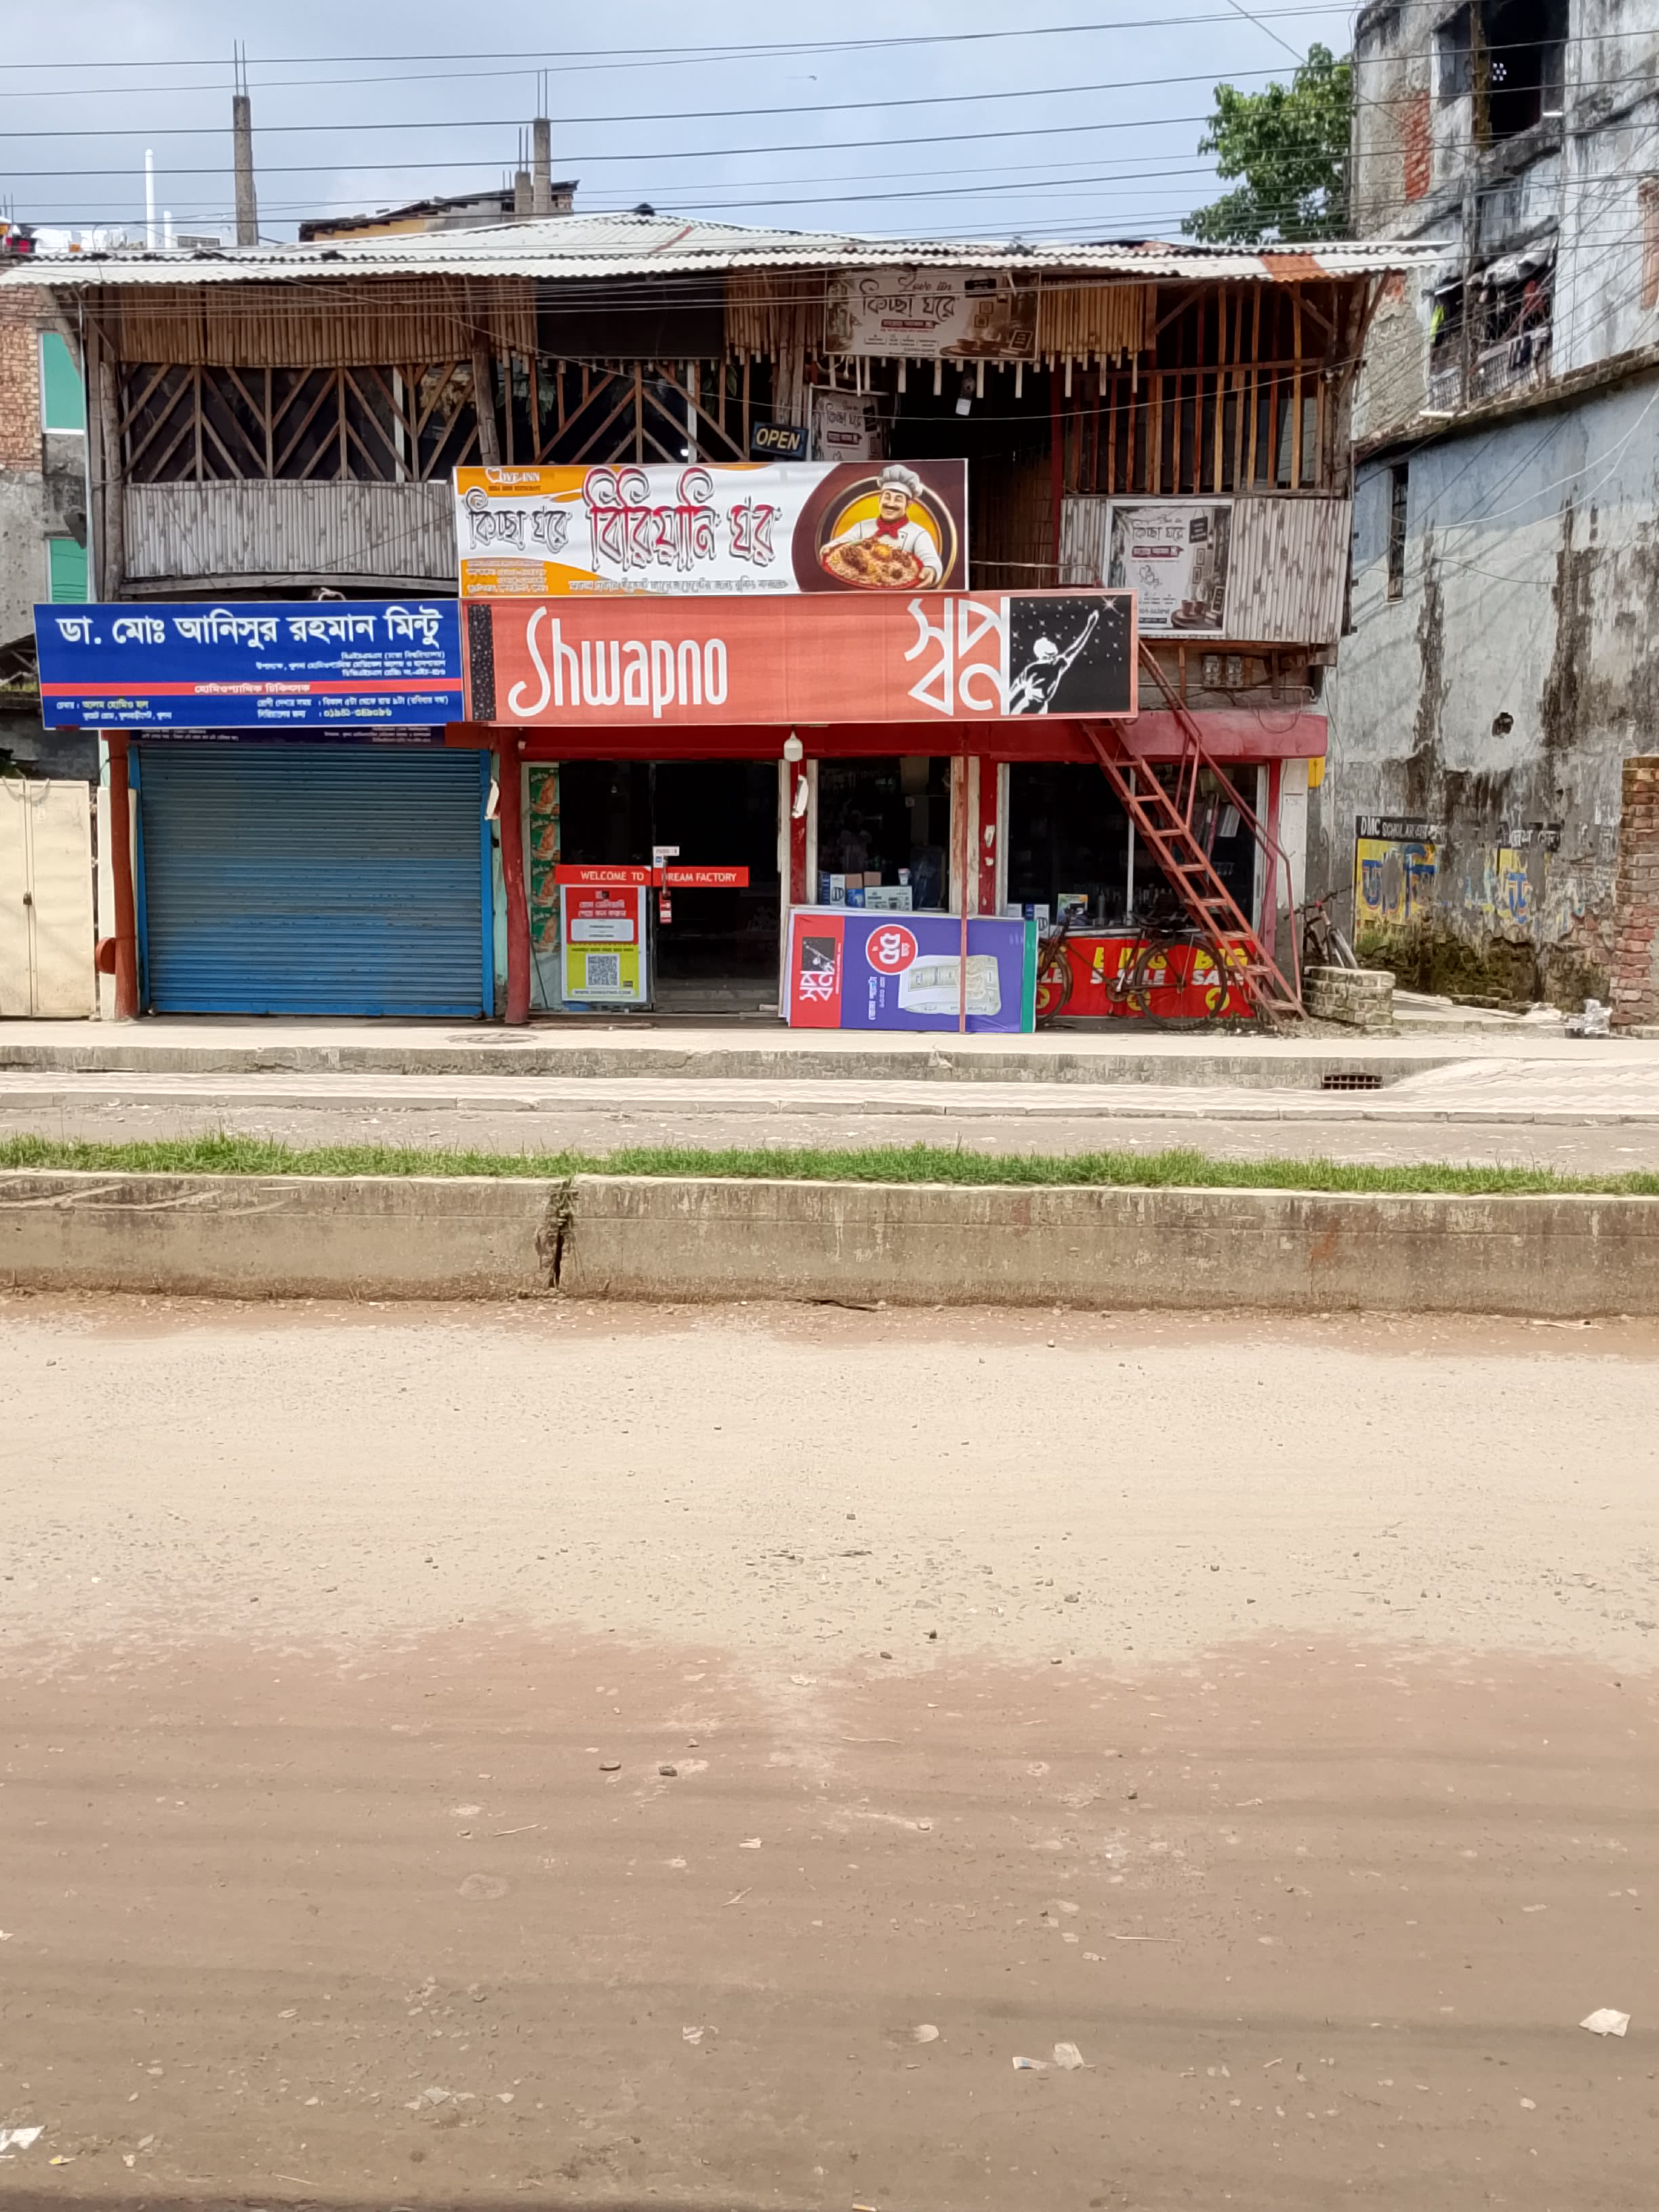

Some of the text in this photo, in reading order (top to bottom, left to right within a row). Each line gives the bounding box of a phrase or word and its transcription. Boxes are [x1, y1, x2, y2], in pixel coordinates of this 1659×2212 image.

[756, 428, 800, 451] OPEN
[531, 506, 573, 554] ঘরে
[726, 495, 783, 567] ঘর
[56, 604, 444, 650] ডা. মোঃ আনিসুর রহমান মিন্টু
[508, 605, 728, 718] Shwapno
[1360, 815, 1380, 836] DMC
[580, 871, 644, 882] WELCOME TO
[696, 872, 737, 882] FACTORY
